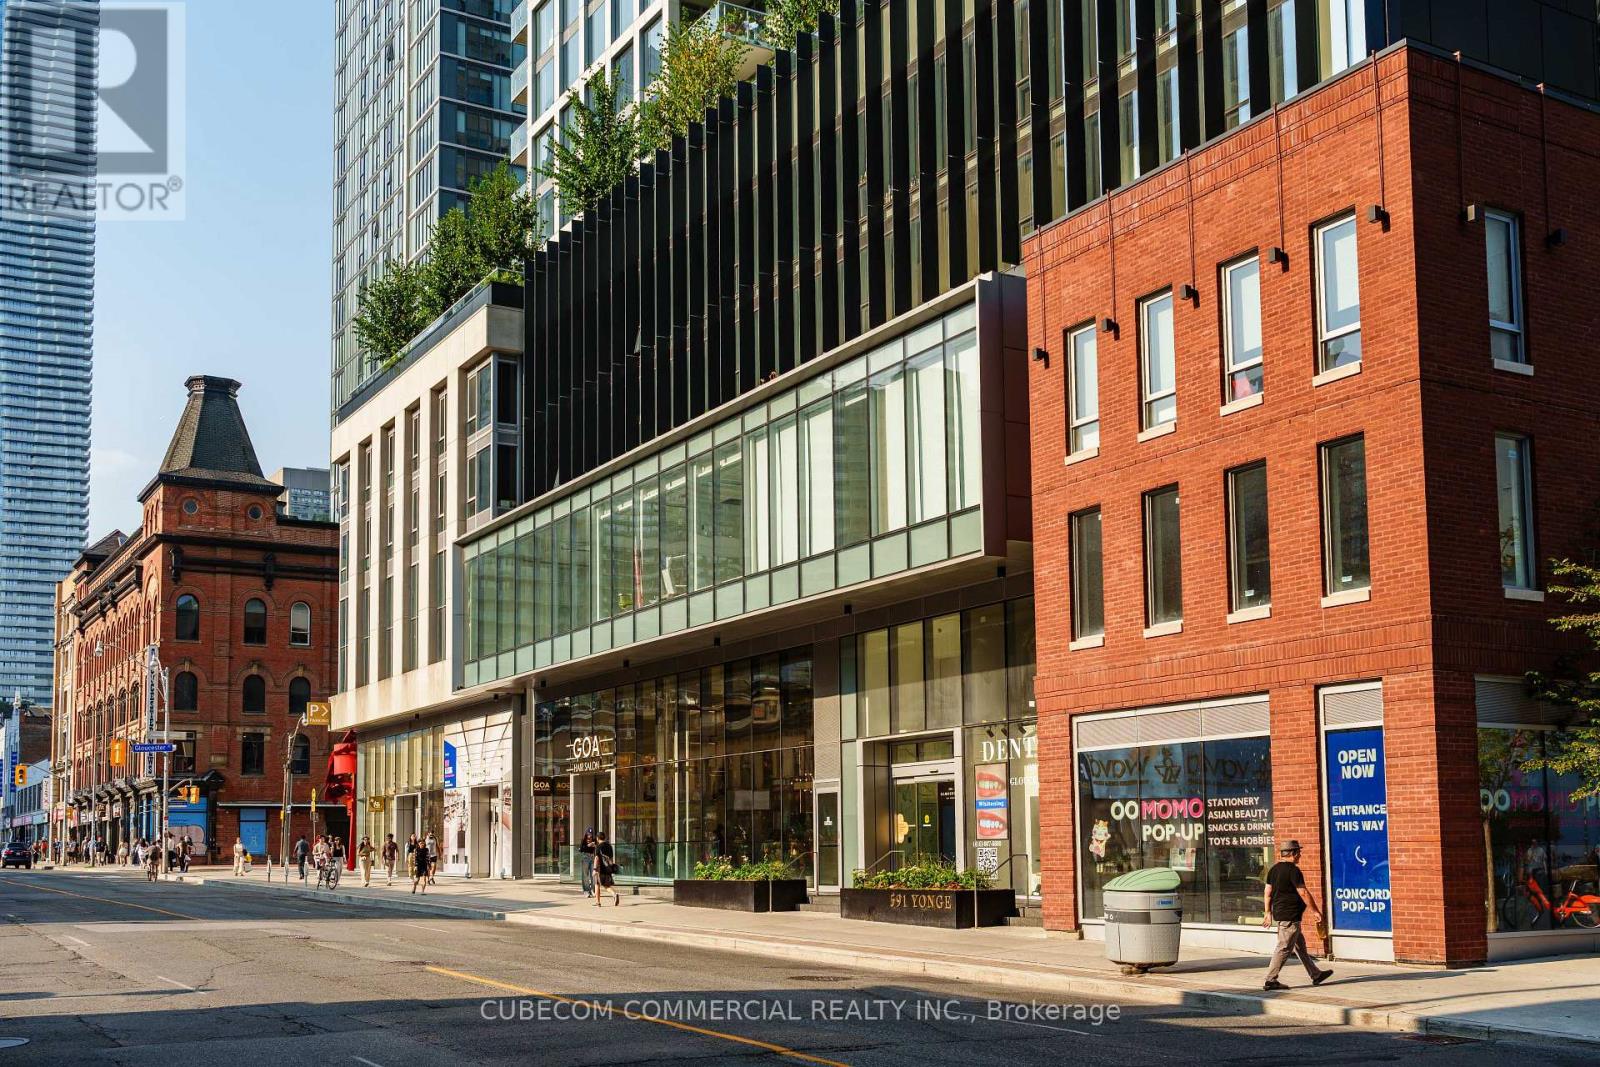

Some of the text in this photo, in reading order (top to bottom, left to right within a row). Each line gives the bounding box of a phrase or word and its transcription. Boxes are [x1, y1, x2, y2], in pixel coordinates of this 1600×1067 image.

[310, 704, 319, 717] P
[573, 736, 600, 759] GOA
[1338, 748, 1377, 764] OPEN
[573, 760, 600, 772] HAIR SALON
[1341, 764, 1375, 779] NOW
[1207, 796, 1260, 808] STATIONERY
[1208, 808, 1269, 820] ASIAN BEAUTY
[1332, 804, 1387, 816] ENTRANCE
[1142, 822, 1204, 842] POP-UP
[1208, 823, 1238, 832] SNACKS
[1239, 822, 1246, 831] &
[1335, 820, 1385, 832] THIS WAY
[1208, 837, 1231, 846] TOYS
[1232, 837, 1239, 845] &
[1335, 888, 1391, 900] CONCORD
[890, 893, 952, 909] 591 YONGE
[1341, 901, 1386, 913] POP-UP
